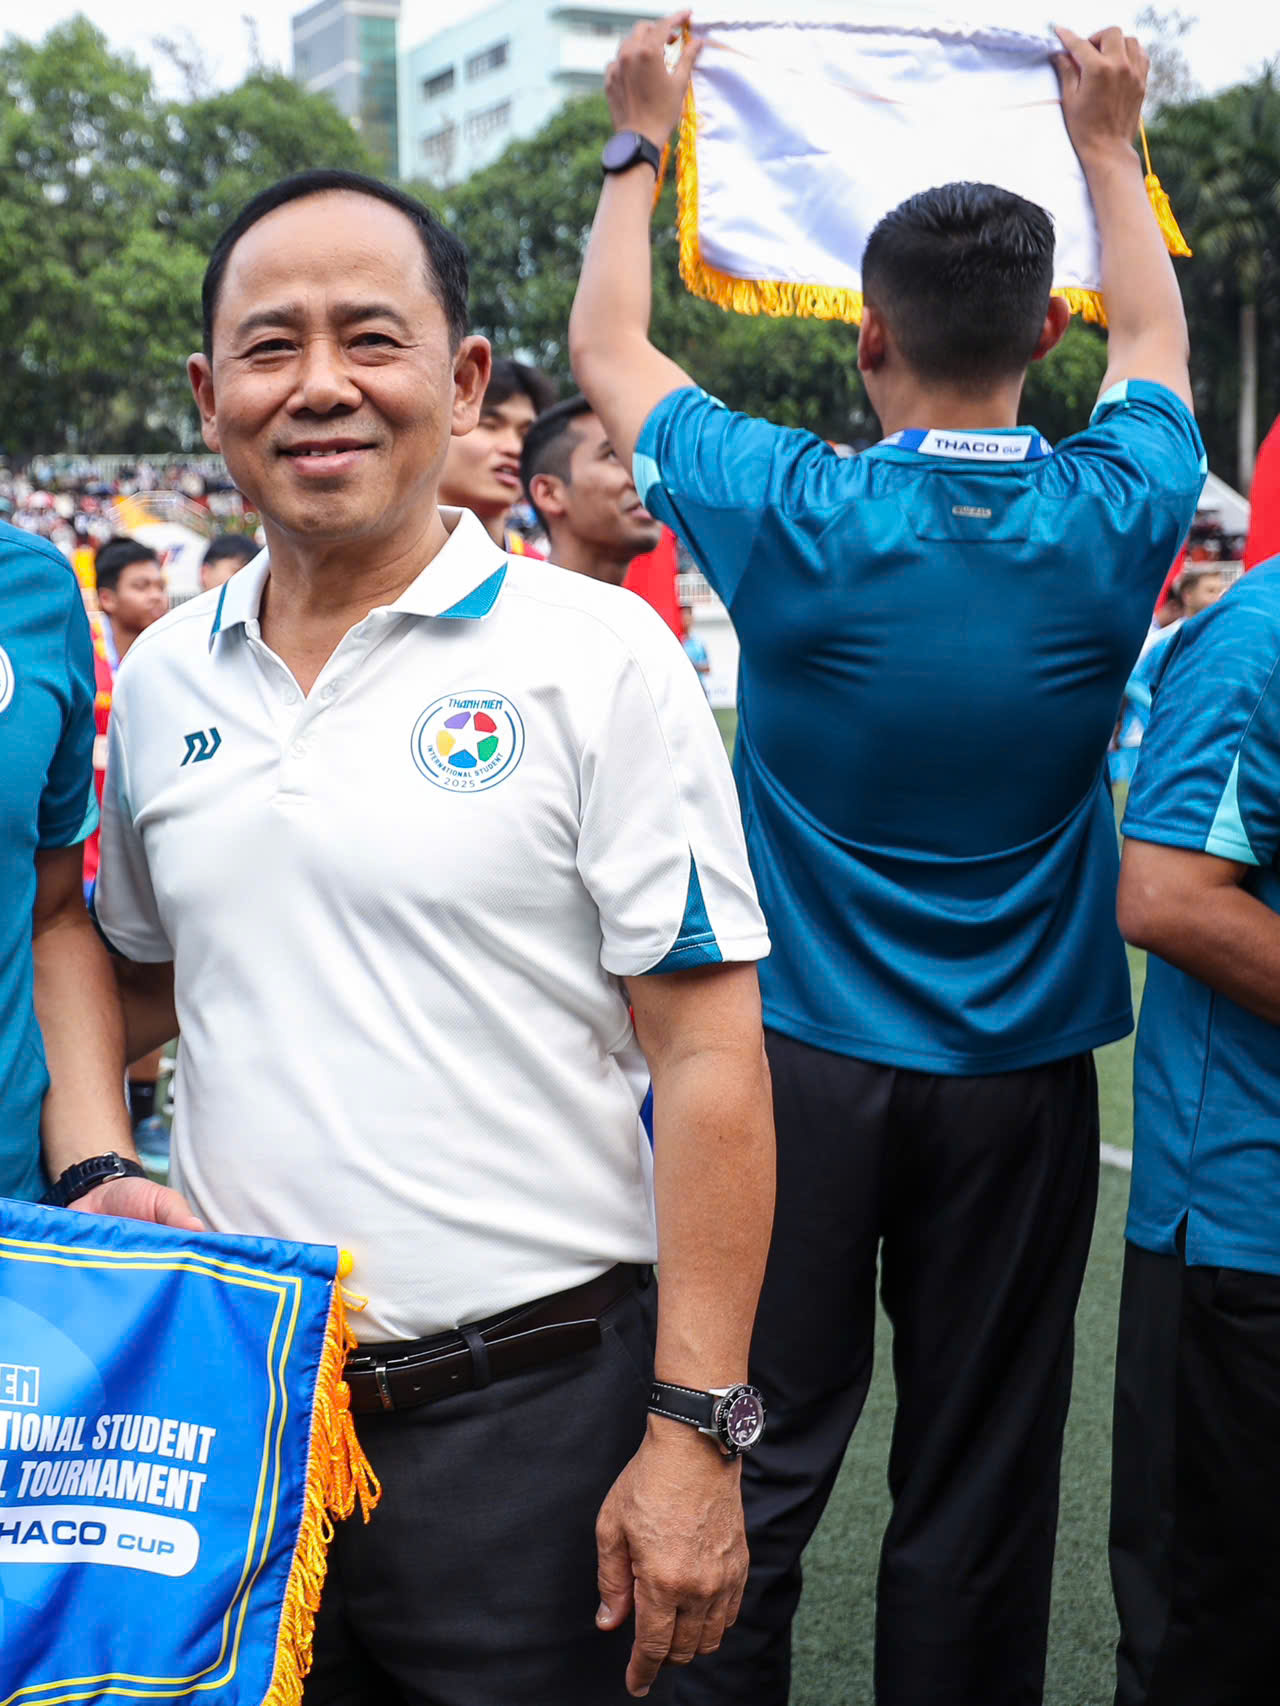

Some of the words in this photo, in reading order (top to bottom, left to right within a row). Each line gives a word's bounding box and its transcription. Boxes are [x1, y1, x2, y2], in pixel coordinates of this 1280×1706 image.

[934, 438, 999, 453] THACO
[1002, 446, 1021, 454] CUP
[427, 744, 472, 778] INTERNATIONAL
[475, 752, 503, 777] STUDENT
[443, 777, 476, 788] 2025
[92, 1414, 217, 1465] STUDENT
[17, 1459, 208, 1513] TOURNAMENT
[116, 1533, 175, 1556] CUP
